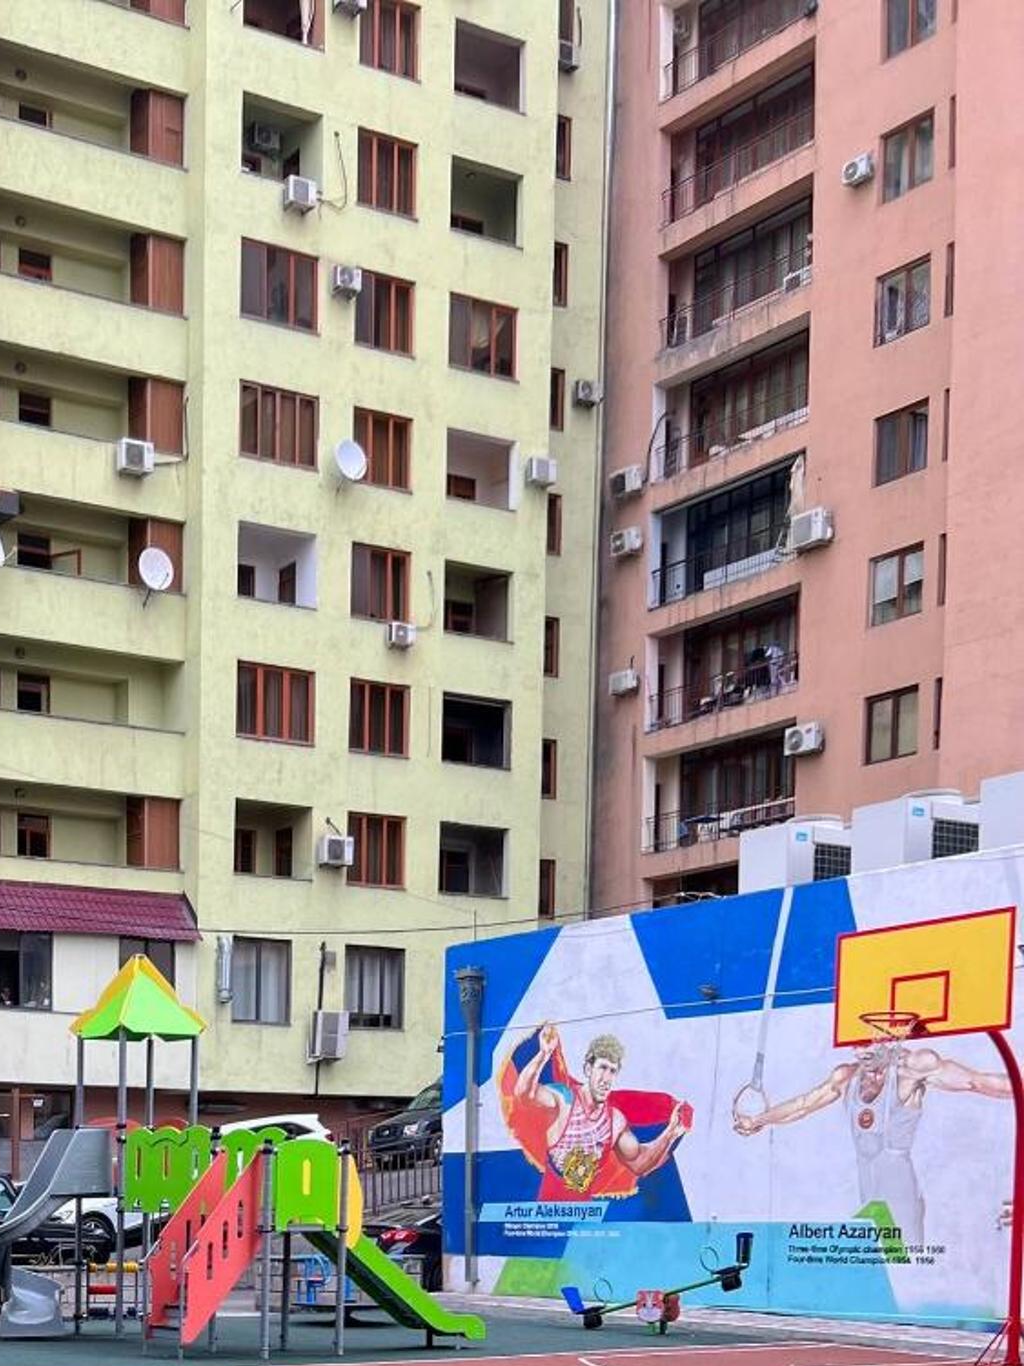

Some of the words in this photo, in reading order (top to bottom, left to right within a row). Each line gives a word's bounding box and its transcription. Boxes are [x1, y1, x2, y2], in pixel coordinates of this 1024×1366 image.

[505, 1205, 533, 1218] Artur
[536, 1204, 602, 1221] Aleksanyan
[788, 1224, 834, 1239] Albert
[838, 1224, 902, 1242] Azaryan
